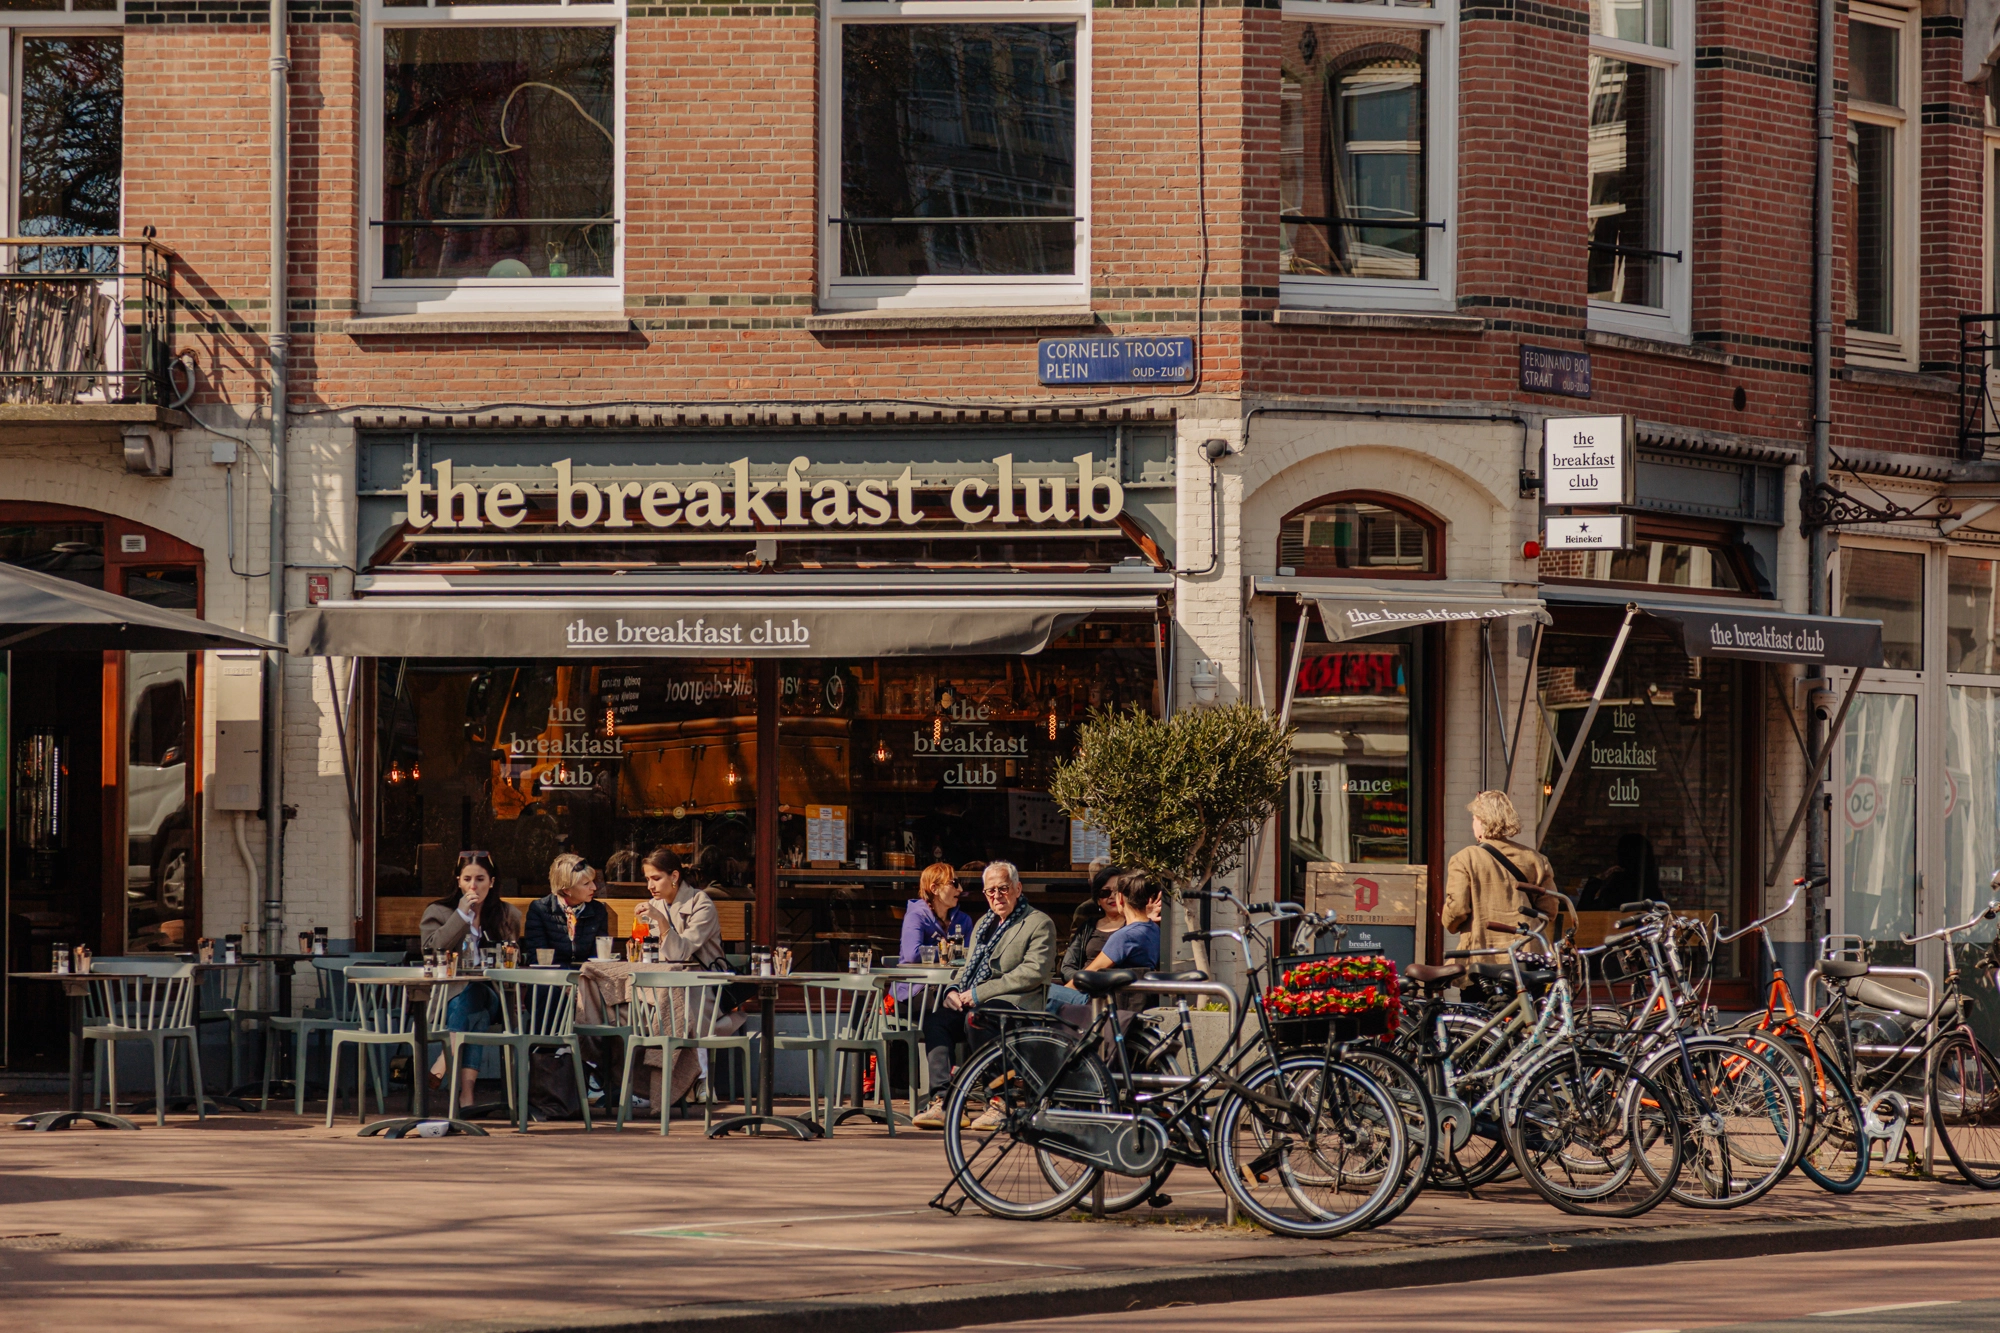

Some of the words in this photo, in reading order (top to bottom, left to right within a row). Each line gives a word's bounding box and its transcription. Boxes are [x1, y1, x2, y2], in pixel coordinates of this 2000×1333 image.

[1047, 342, 1120, 359] CORNELIS
[1125, 341, 1185, 357] TROOST
[1047, 363, 1089, 379] PLEIN
[1132, 366, 1185, 378] OUD-ZUID
[1524, 351, 1572, 371] FERDINAND
[1574, 357, 1590, 374] BOL
[1524, 370, 1554, 388] STRAAT
[1562, 380, 1590, 393] OUD-ZUID
[1573, 431, 1595, 445] the
[1552, 452, 1615, 467] breakfast
[402, 458, 528, 529] the
[551, 454, 926, 528] breakfast
[950, 451, 1124, 524] club
[1568, 473, 1599, 488] club
[1565, 535, 1603, 544] Heineken
[1346, 608, 1382, 624] the
[1381, 608, 1481, 622] breakfast
[566, 618, 609, 643] the
[616, 618, 744, 644] breakfast
[750, 618, 810, 644] club
[1710, 622, 1733, 646] the
[1733, 623, 1794, 650] breakfast
[1795, 628, 1825, 652] club
[548, 700, 586, 722] the
[950, 698, 990, 721] the
[1613, 704, 1636, 729] the
[509, 732, 624, 754] breakfast
[912, 731, 1029, 753] breakfast
[1591, 740, 1657, 766] breakfast
[540, 764, 593, 786] club
[943, 763, 997, 785] club
[1307, 778, 1392, 793] enance
[1608, 777, 1640, 802] club
[1353, 877, 1379, 913] D
[1368, 915, 1384, 923] 1871
[1348, 940, 1382, 949] breakfast
[1359, 931, 1372, 940] the
